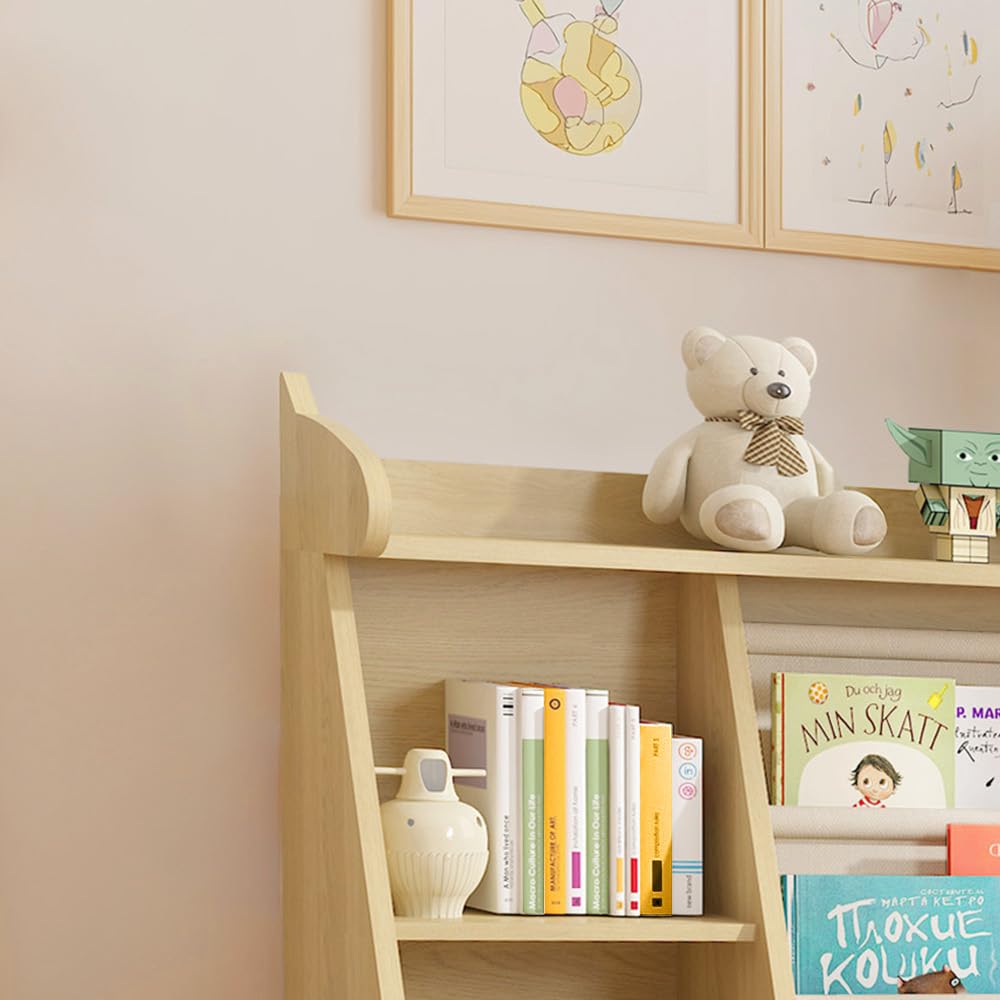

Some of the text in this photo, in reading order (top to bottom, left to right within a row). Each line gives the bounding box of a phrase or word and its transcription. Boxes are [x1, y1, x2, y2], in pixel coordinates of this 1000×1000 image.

[845, 684, 903, 702] Du och jag
[956, 706, 967, 720] P.
[800, 703, 949, 753] MIN SKATT
[528, 793, 537, 811] Life
[592, 793, 601, 811] Life
[528, 811, 537, 830] Our
[592, 811, 601, 830] Our
[528, 842, 537, 877] Culture
[592, 842, 601, 877] Culture
[528, 878, 537, 910] Macro
[592, 878, 601, 910] Macro
[931, 895, 985, 907] КЕТРО
